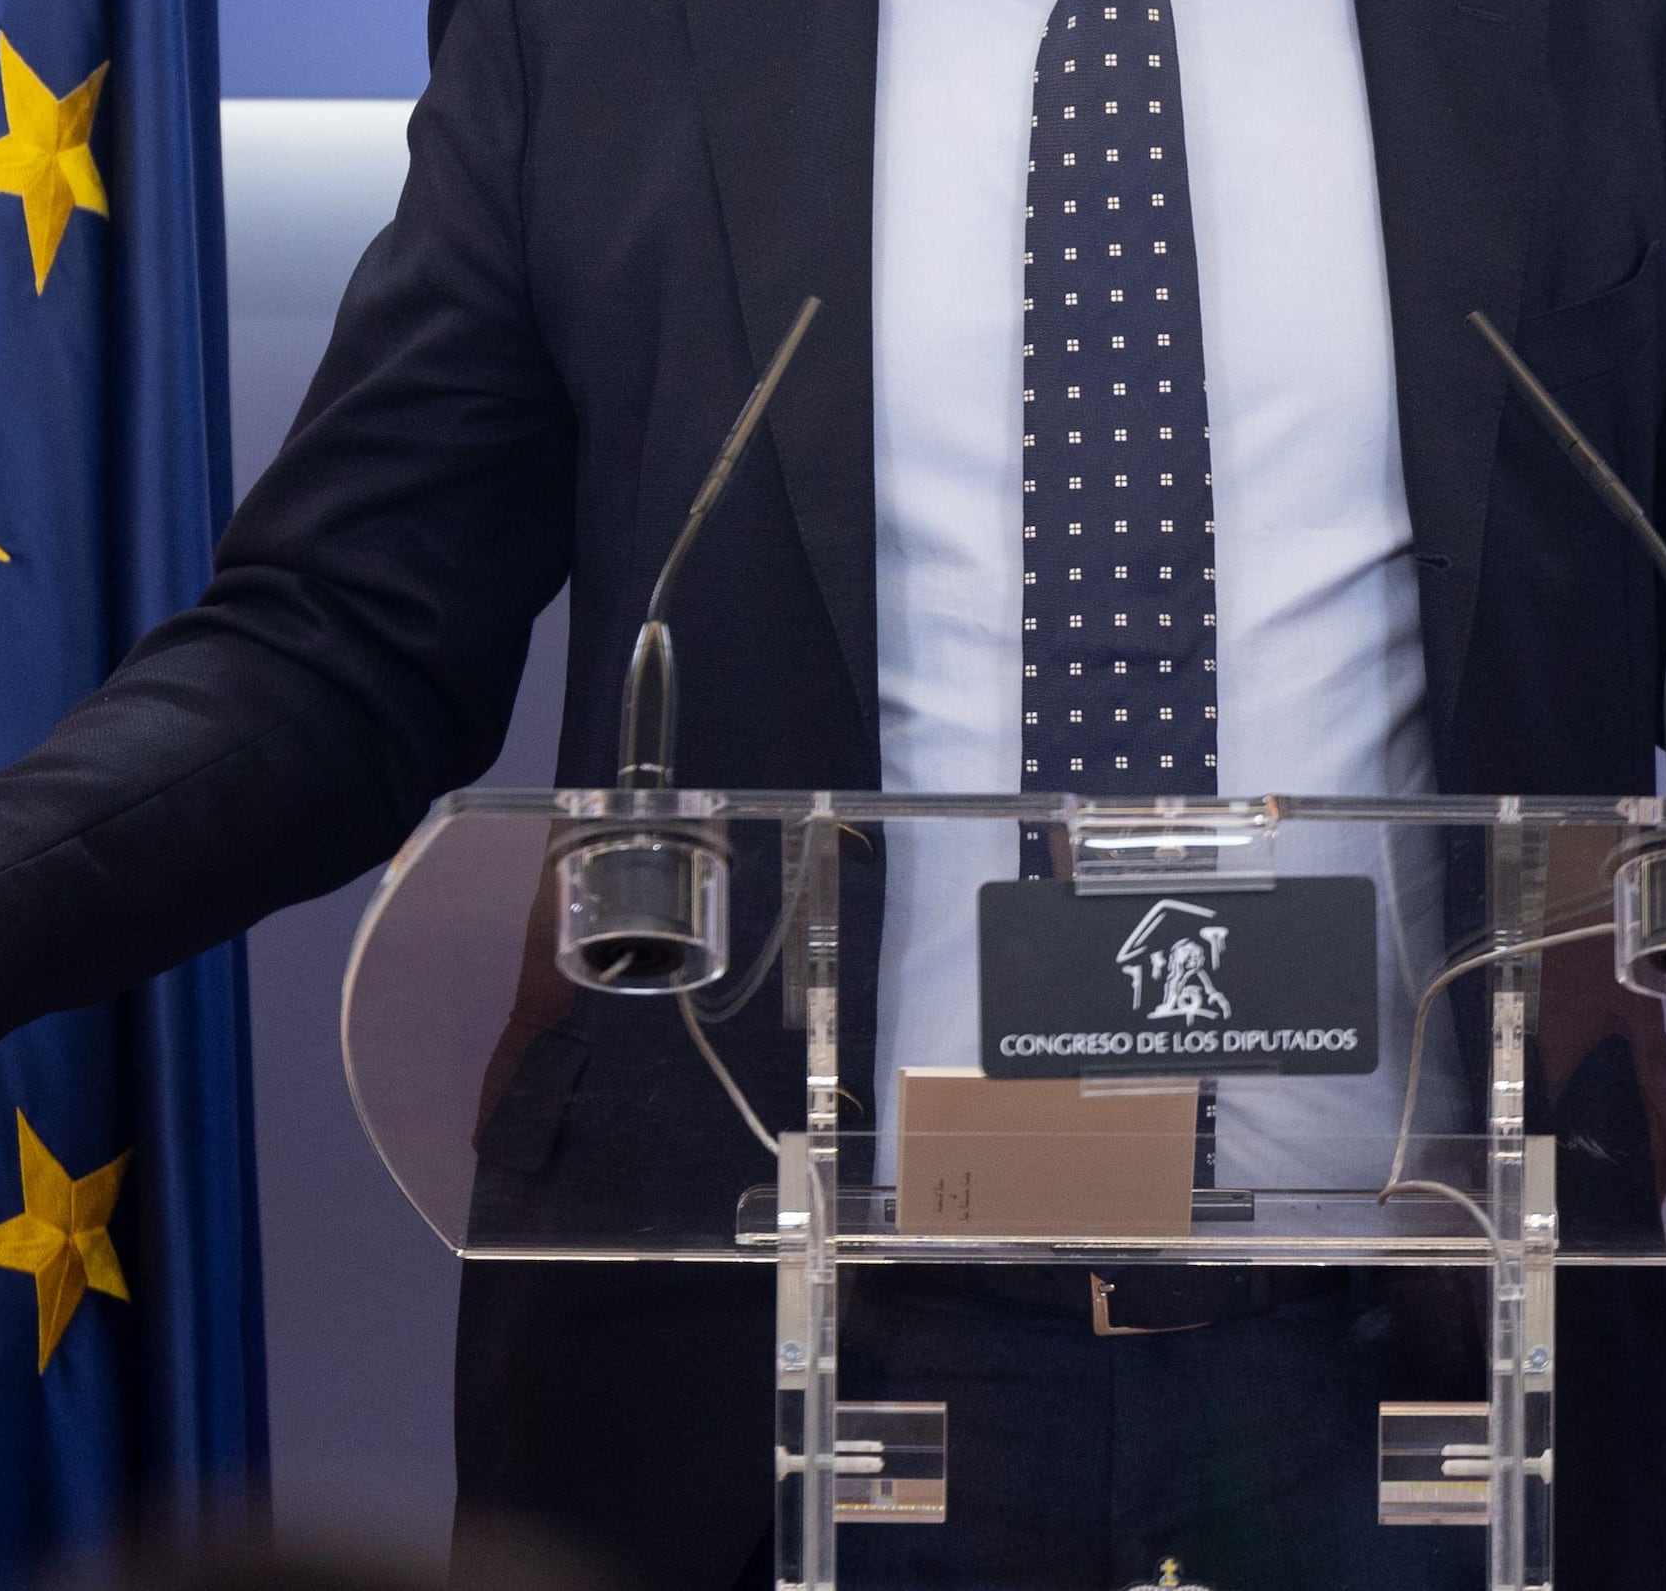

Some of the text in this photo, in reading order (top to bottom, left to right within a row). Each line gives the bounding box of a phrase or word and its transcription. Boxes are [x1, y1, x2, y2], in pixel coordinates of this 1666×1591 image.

[1000, 1027, 1358, 1057] CONGRESO DE LOS DIPUTADOS
